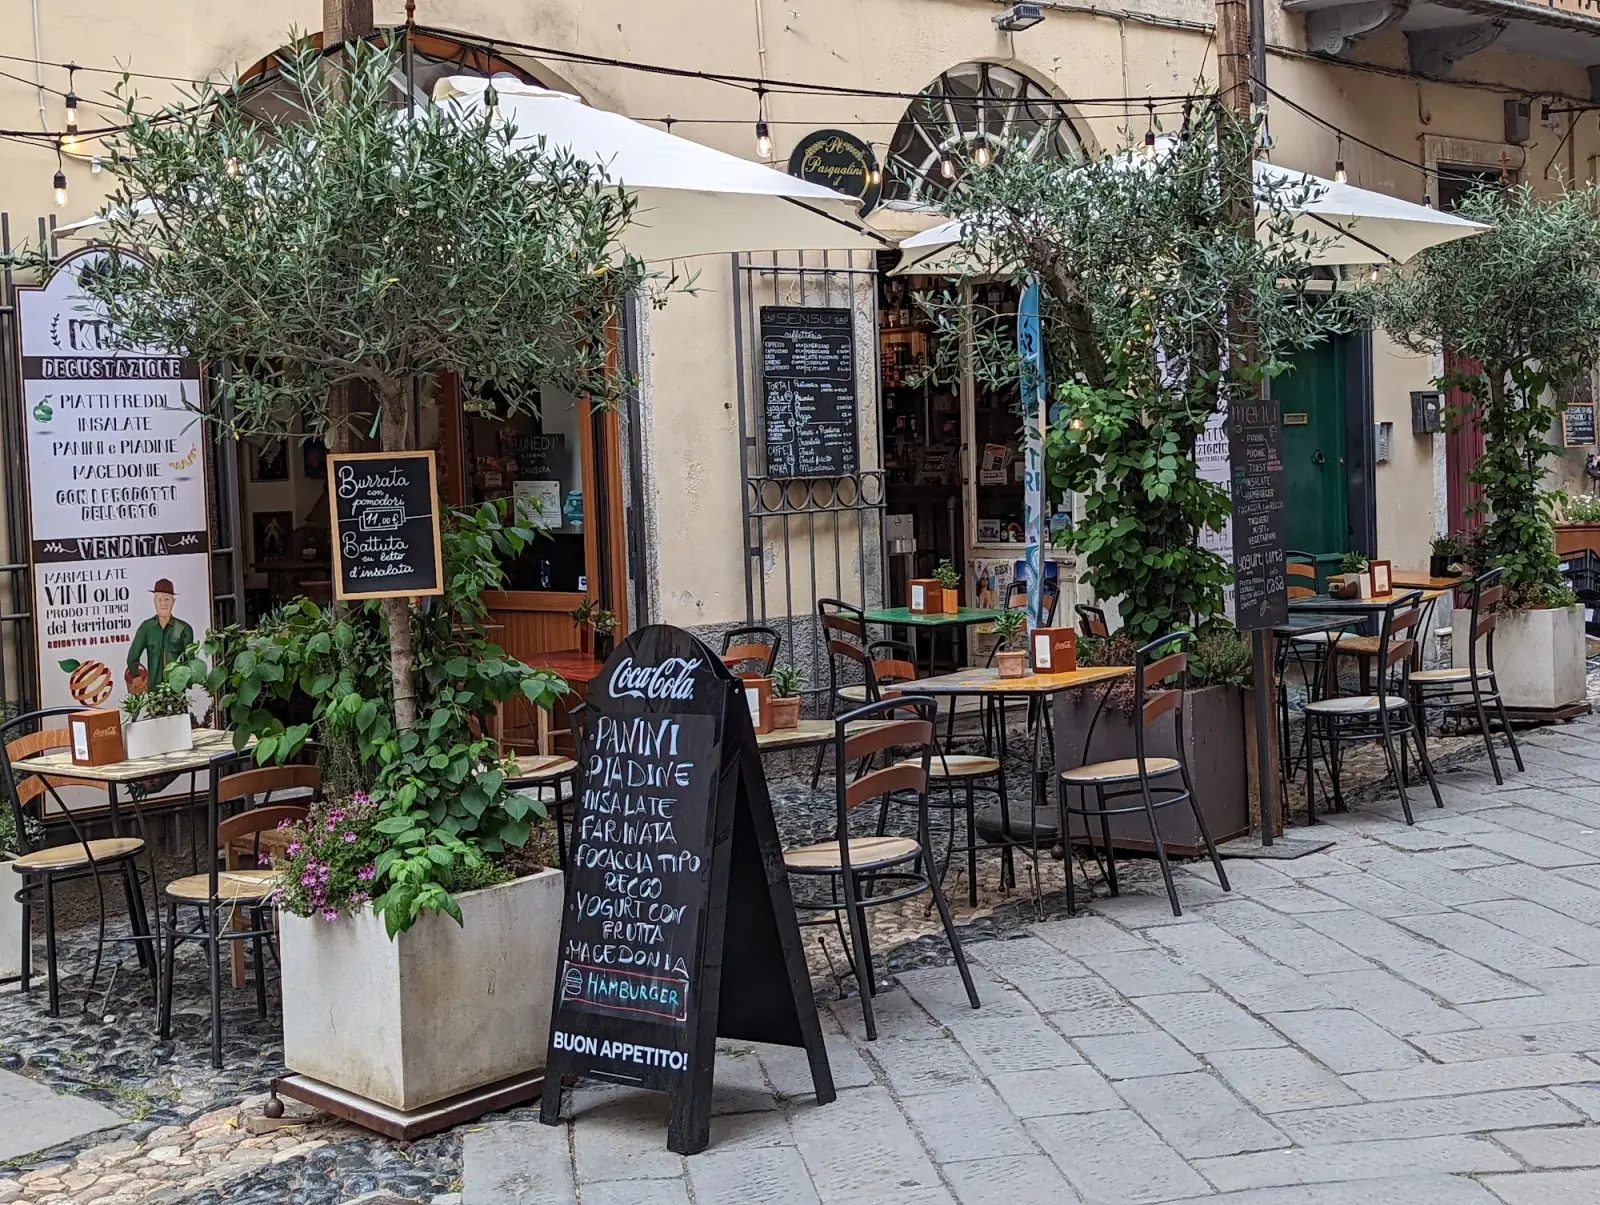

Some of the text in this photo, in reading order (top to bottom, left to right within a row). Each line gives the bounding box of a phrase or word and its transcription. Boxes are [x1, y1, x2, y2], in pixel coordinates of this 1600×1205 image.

[805, 155, 863, 178] Pasqualini
[776, 312, 831, 325] SENSU
[42, 358, 181, 379] DEGUSTAZIONE
[60, 393, 168, 409] PIATTI FREDDI
[78, 417, 152, 432] INSALATE
[1231, 405, 1277, 424] menu
[53, 439, 179, 456] PANINI e PIADINE
[1246, 434, 1265, 443] PANINI
[73, 462, 163, 480] MACEDONIE
[1248, 463, 1267, 472] TOAST
[338, 465, 410, 499] Burrata
[1245, 476, 1271, 487] INSALATE
[56, 485, 177, 505] CON I PRODOTTI
[352, 493, 405, 517] pomodori
[81, 503, 160, 522] DELL'ORTO
[76, 535, 168, 559] VENDITA
[342, 531, 409, 559] Battuta
[380, 552, 405, 562] letto
[44, 568, 129, 584] MARMELLATE
[349, 564, 415, 579] d'insalata
[44, 584, 130, 606] VINI OLIO
[46, 603, 129, 620] PRODOTTI TIPICI
[47, 616, 131, 636] del territorio
[47, 637, 87, 650] CHINOTTO
[89, 636, 98, 645] DI
[608, 656, 704, 700] Coca-Cola
[595, 716, 680, 759] PANINI
[588, 754, 694, 790] PIADINE
[583, 788, 678, 819] INSALATE
[580, 814, 678, 845] FARINATA
[576, 843, 701, 874] FOCACCIA TIPO
[604, 872, 663, 899] RECCO
[576, 890, 689, 925] YOGURT CON
[602, 920, 665, 945] FRUTTA
[568, 939, 690, 979] MACEDONIA
[587, 971, 680, 1007] HAMBURGER
[553, 1030, 689, 1072] BUON APPETITO!
